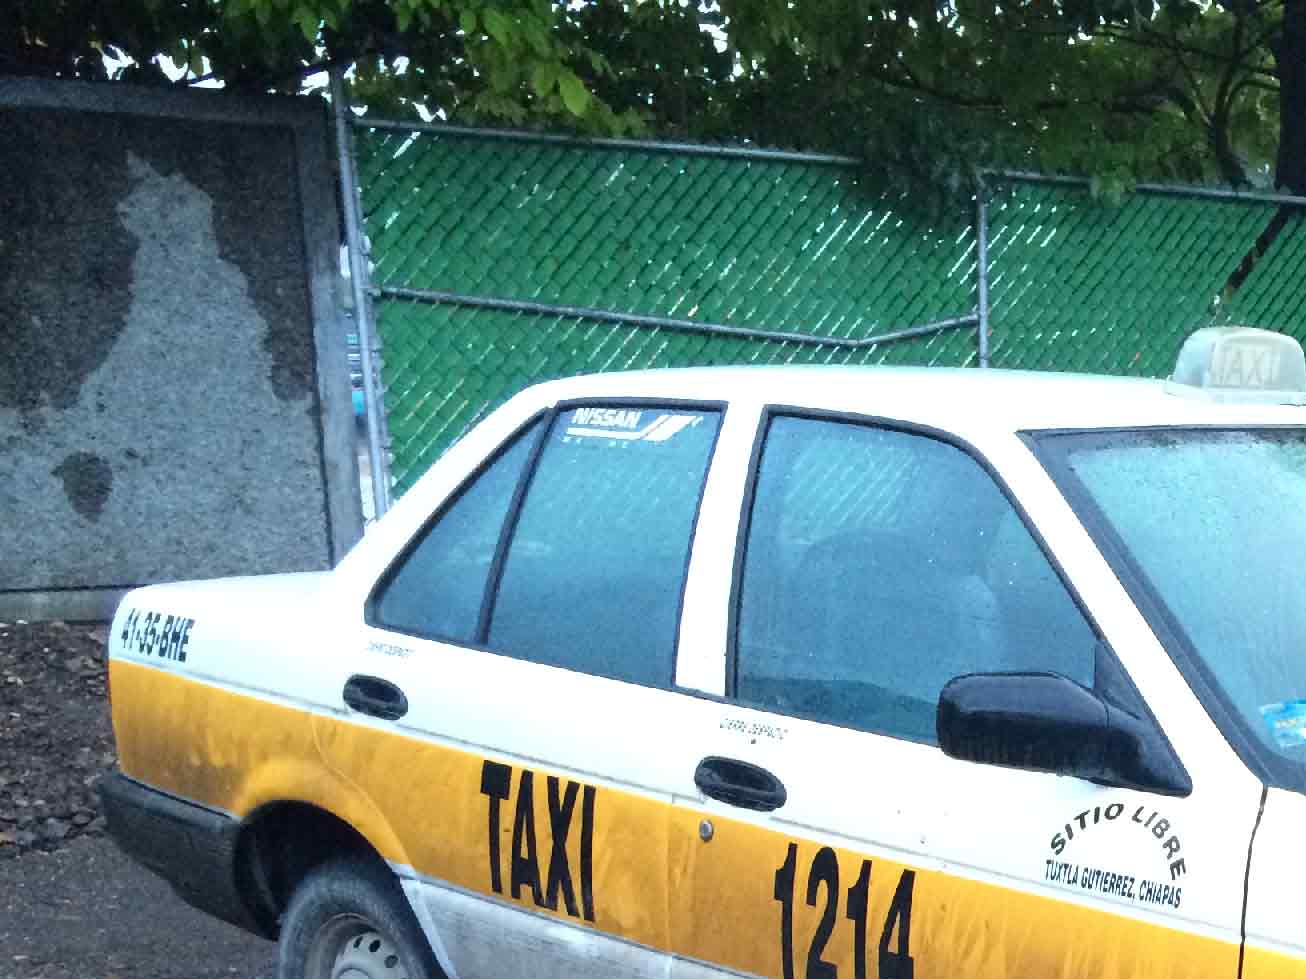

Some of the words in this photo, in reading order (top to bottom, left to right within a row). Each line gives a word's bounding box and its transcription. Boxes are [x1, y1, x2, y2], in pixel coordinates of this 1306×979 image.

[1211, 341, 1281, 386] TAXI
[573, 407, 641, 428] NISSAN
[480, 759, 597, 923] TAXI
[1050, 803, 1125, 855] SITIO
[1131, 806, 1187, 880] LIBRE
[1045, 860, 1079, 886] TUXTLA
[1080, 867, 1136, 901] GUTIERREZ,
[1138, 880, 1182, 909] CHIAPAS
